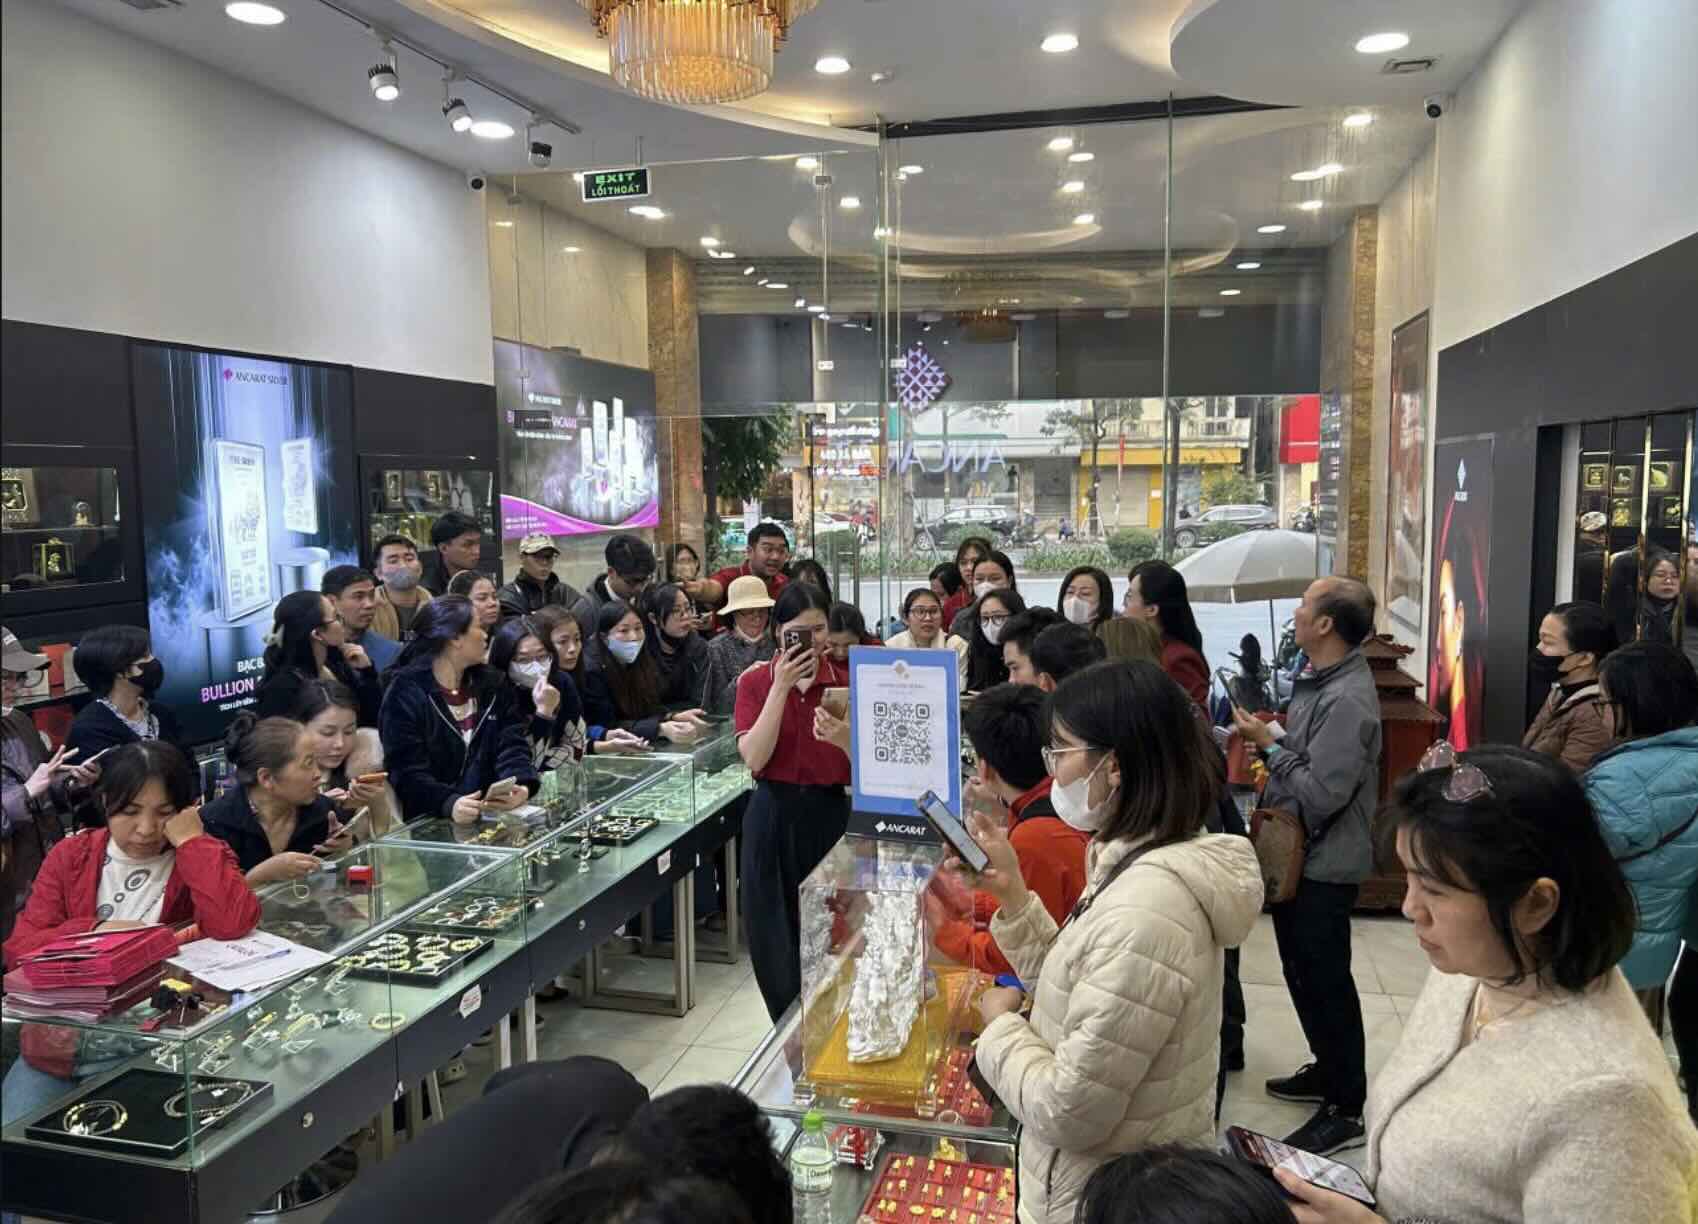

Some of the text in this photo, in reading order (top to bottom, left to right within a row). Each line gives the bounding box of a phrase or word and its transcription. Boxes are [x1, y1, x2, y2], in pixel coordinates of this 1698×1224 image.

[595, 172, 636, 185] EXIT
[201, 677, 255, 703] BULLION
[886, 823, 926, 836] ANCARAT
